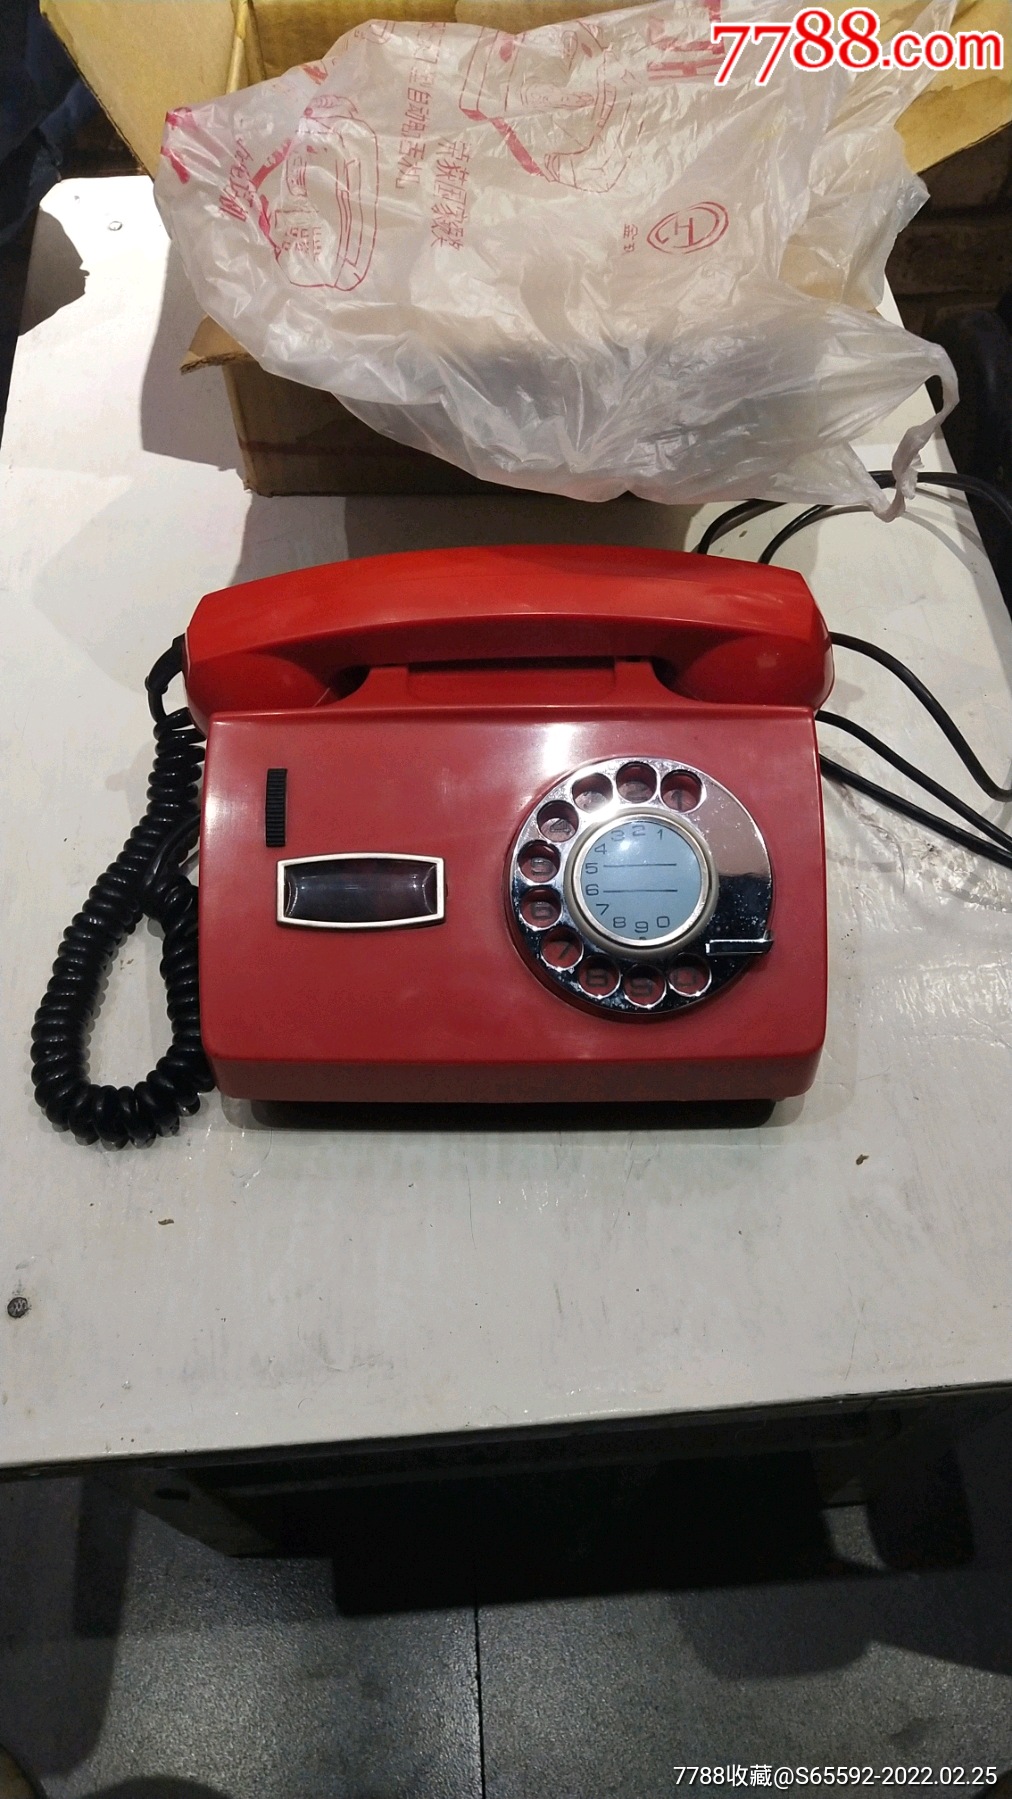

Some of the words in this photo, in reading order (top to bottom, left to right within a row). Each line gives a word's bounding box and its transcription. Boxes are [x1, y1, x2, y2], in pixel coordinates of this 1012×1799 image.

[611, 829, 625, 842] 3
[632, 824, 646, 837] 2
[657, 828, 664, 841] 1
[594, 843, 607, 855] 4
[585, 862, 599, 875] 5
[585, 884, 600, 897] 6
[595, 903, 610, 916] 7
[612, 916, 627, 929] 8
[634, 921, 649, 934] 9
[656, 915, 671, 929] 0
